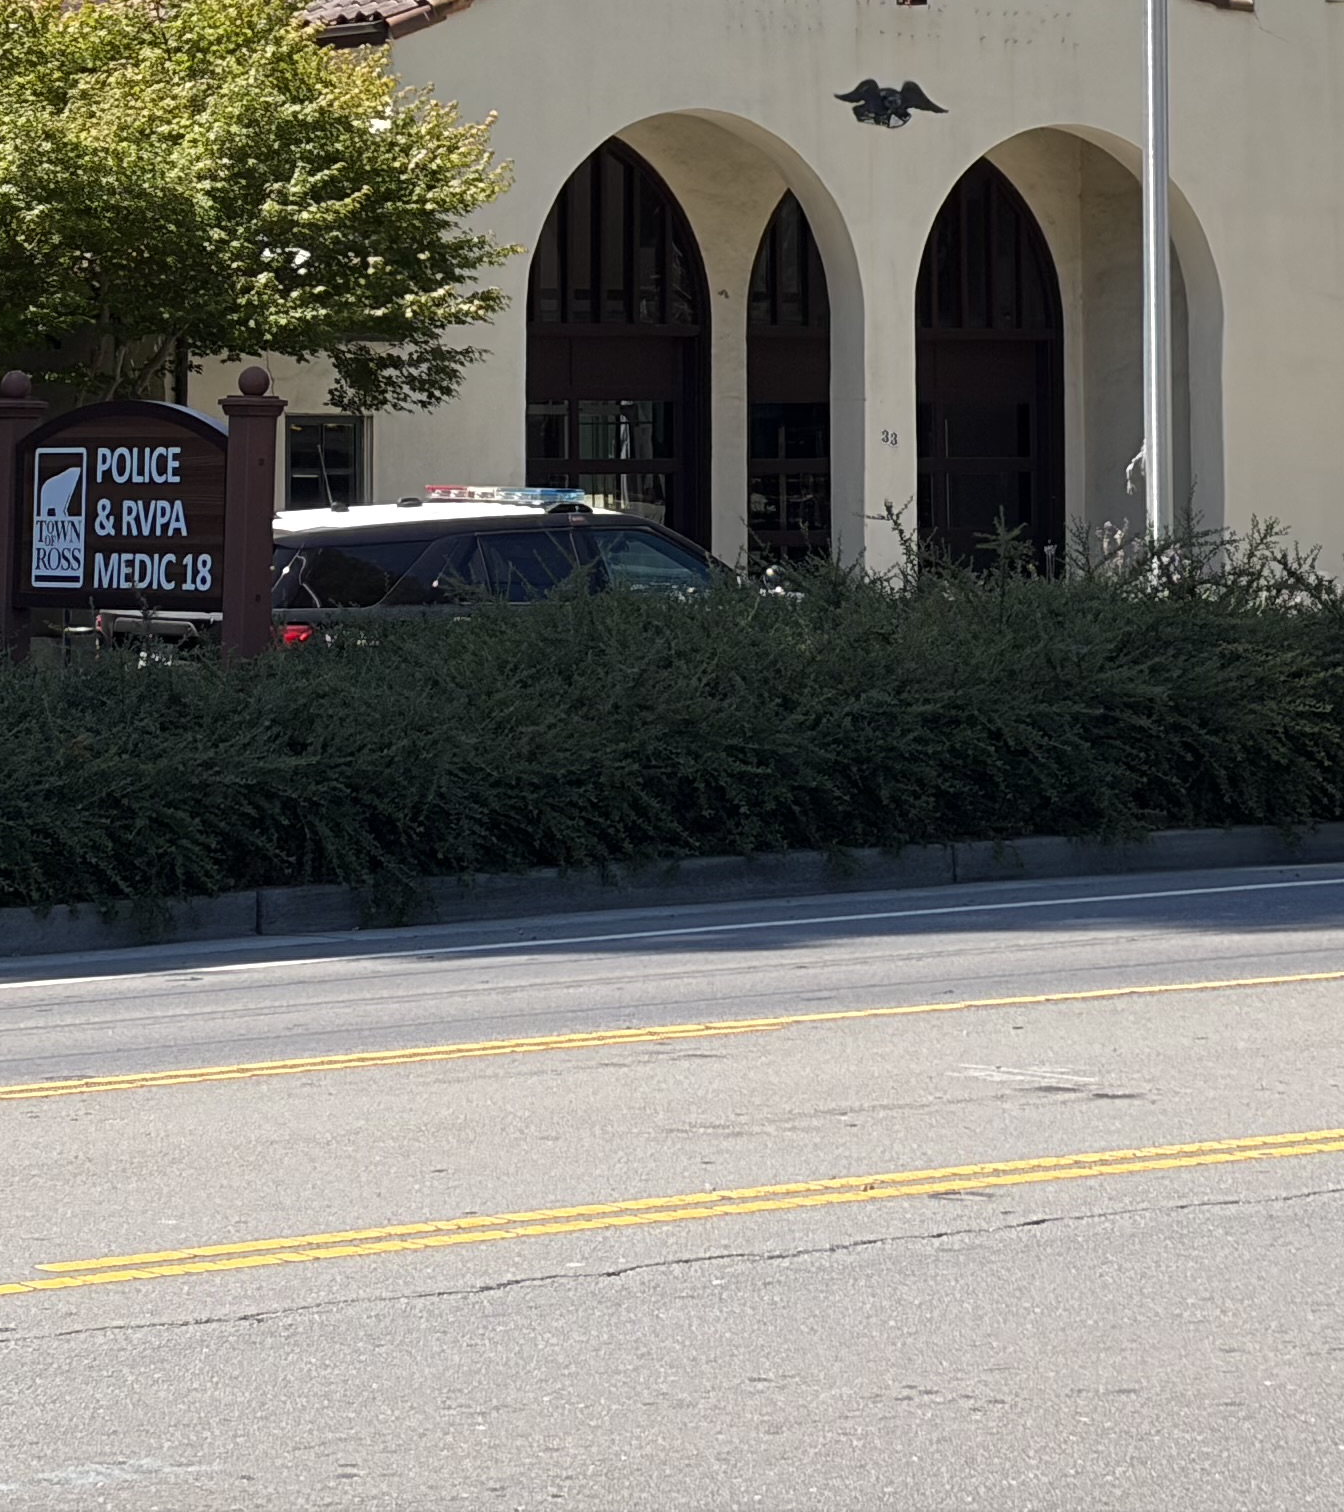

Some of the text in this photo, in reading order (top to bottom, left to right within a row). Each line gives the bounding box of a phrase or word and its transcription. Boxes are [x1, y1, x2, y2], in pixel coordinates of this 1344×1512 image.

[882, 429, 898, 446] 33
[96, 446, 182, 484] POLICE
[94, 498, 188, 537] & RVPA
[35, 519, 82, 544] TOWN
[44, 534, 56, 547] OF
[35, 547, 81, 571] ROSS
[93, 552, 212, 591] MEDIC 18
